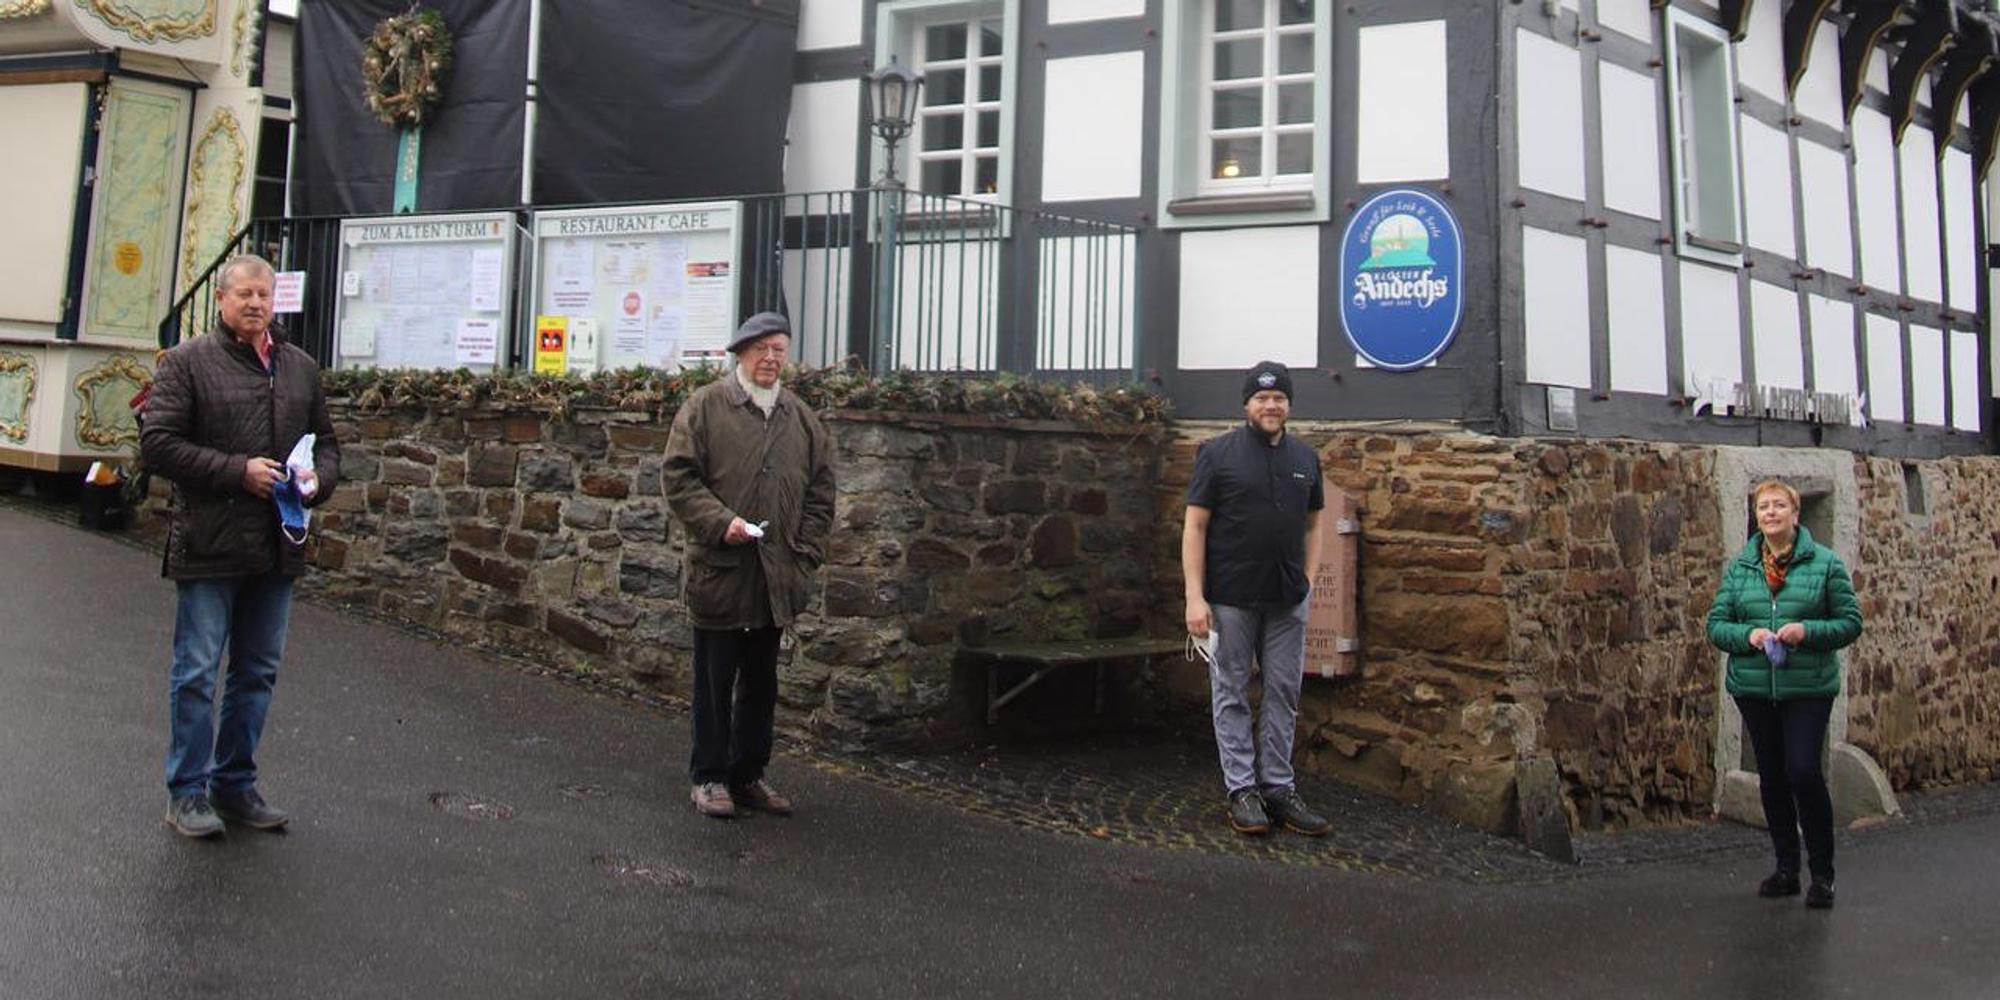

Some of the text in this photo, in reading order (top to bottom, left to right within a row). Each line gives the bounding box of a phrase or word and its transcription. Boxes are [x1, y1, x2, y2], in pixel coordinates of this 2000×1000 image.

[361, 221, 487, 240] ZUM ALTEN TURM
[560, 214, 657, 234] RESTAURANT
[1353, 267, 1448, 309] Andechs
